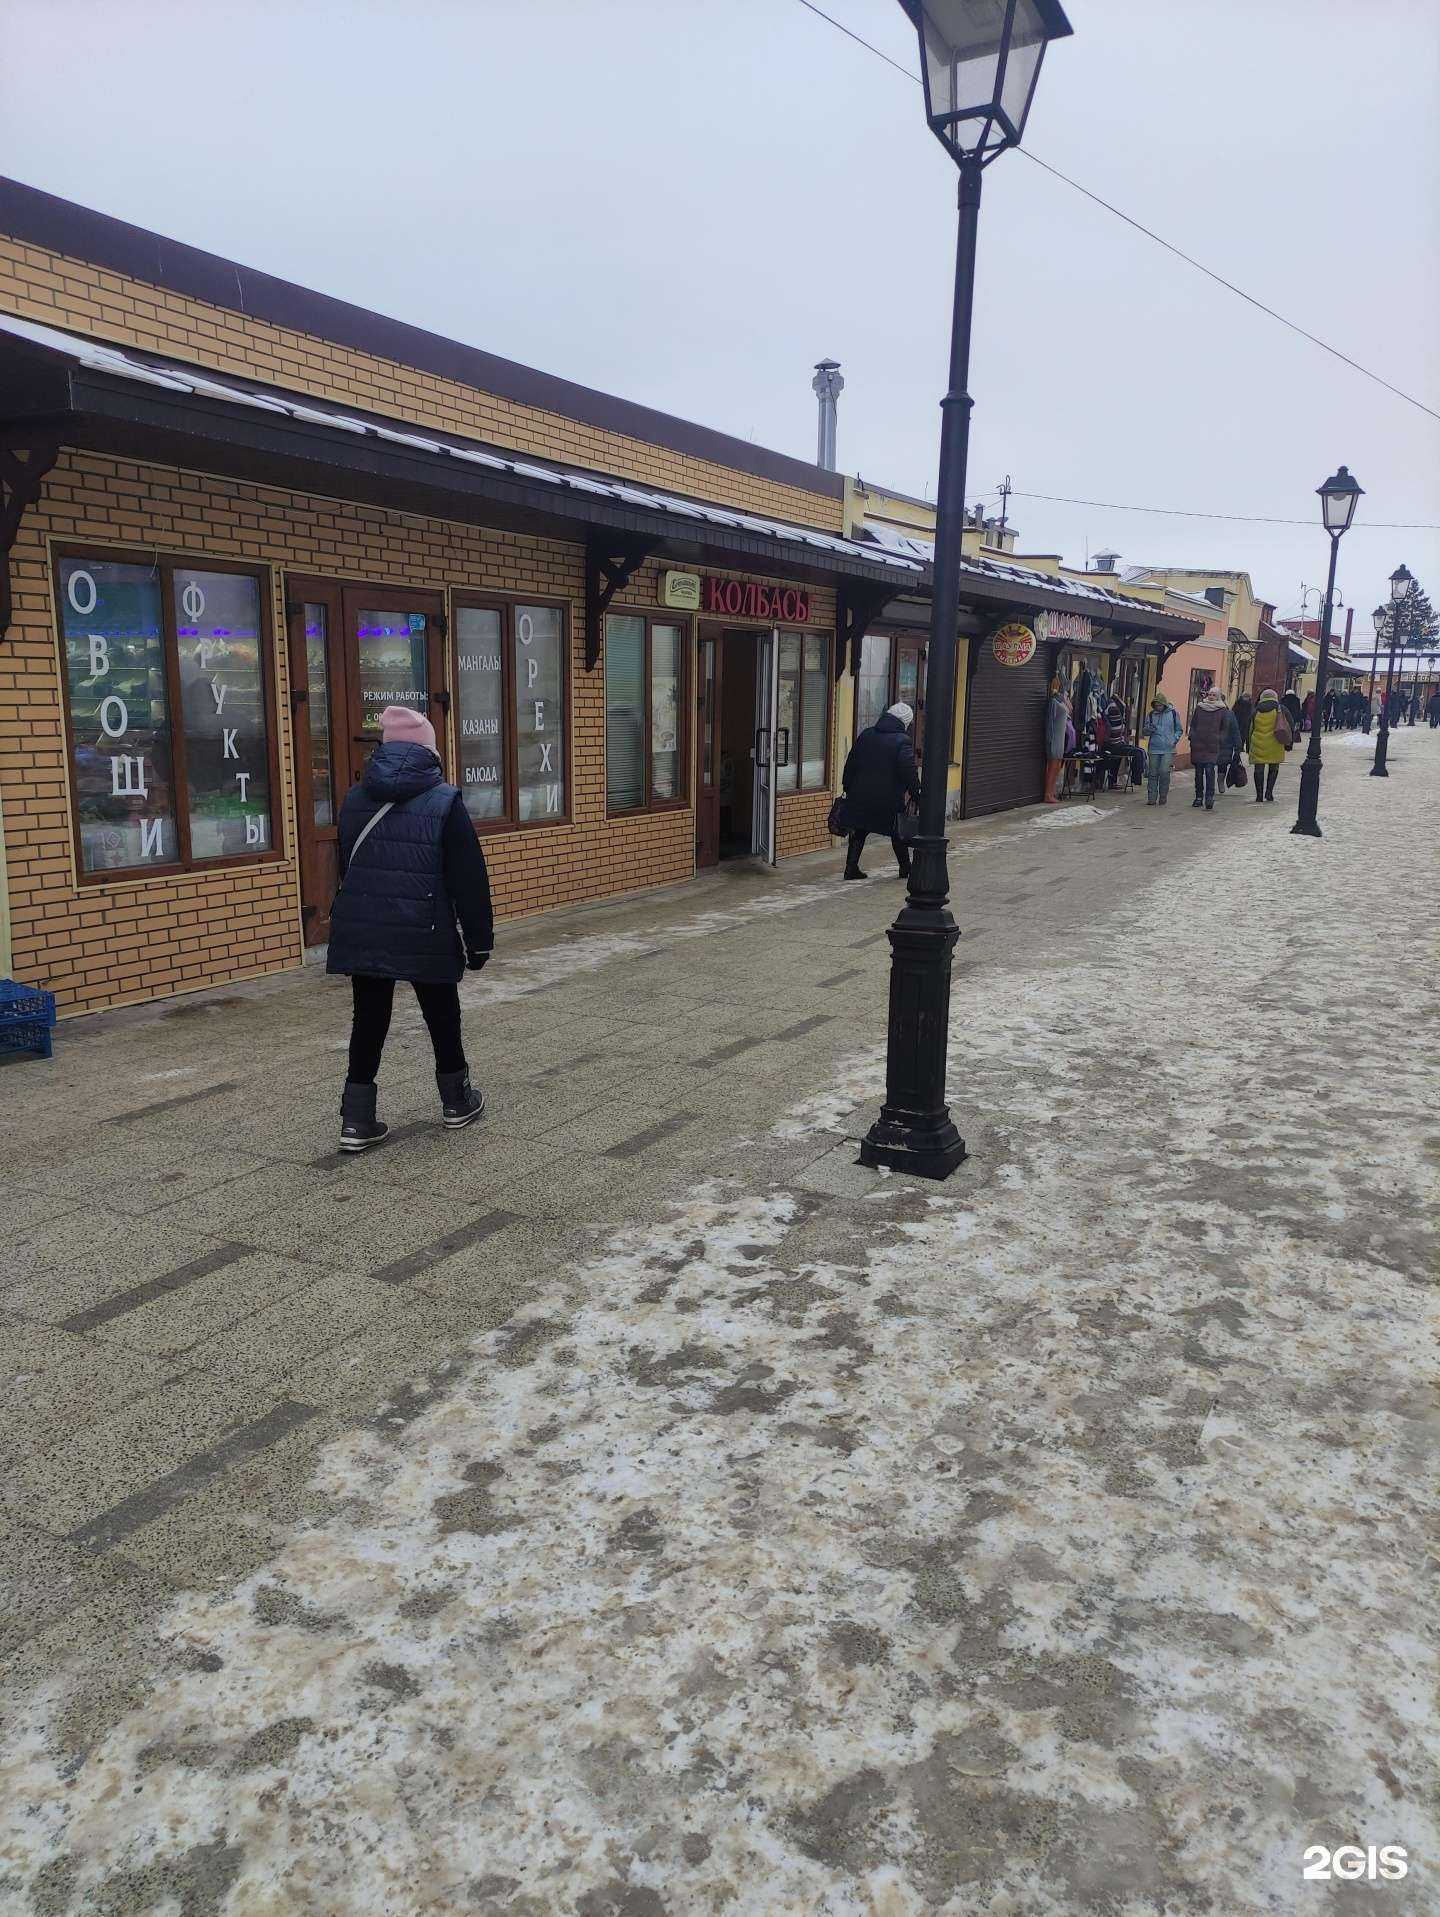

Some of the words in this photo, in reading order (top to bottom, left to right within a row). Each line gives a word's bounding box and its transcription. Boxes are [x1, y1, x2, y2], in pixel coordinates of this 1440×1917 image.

[458, 655, 501, 671] МАНГАЛЫ
[363, 691, 394, 701] РЕЖИМ
[462, 718, 499, 735] КАЗАНЫ
[465, 766, 498, 783] БЛЮДА
